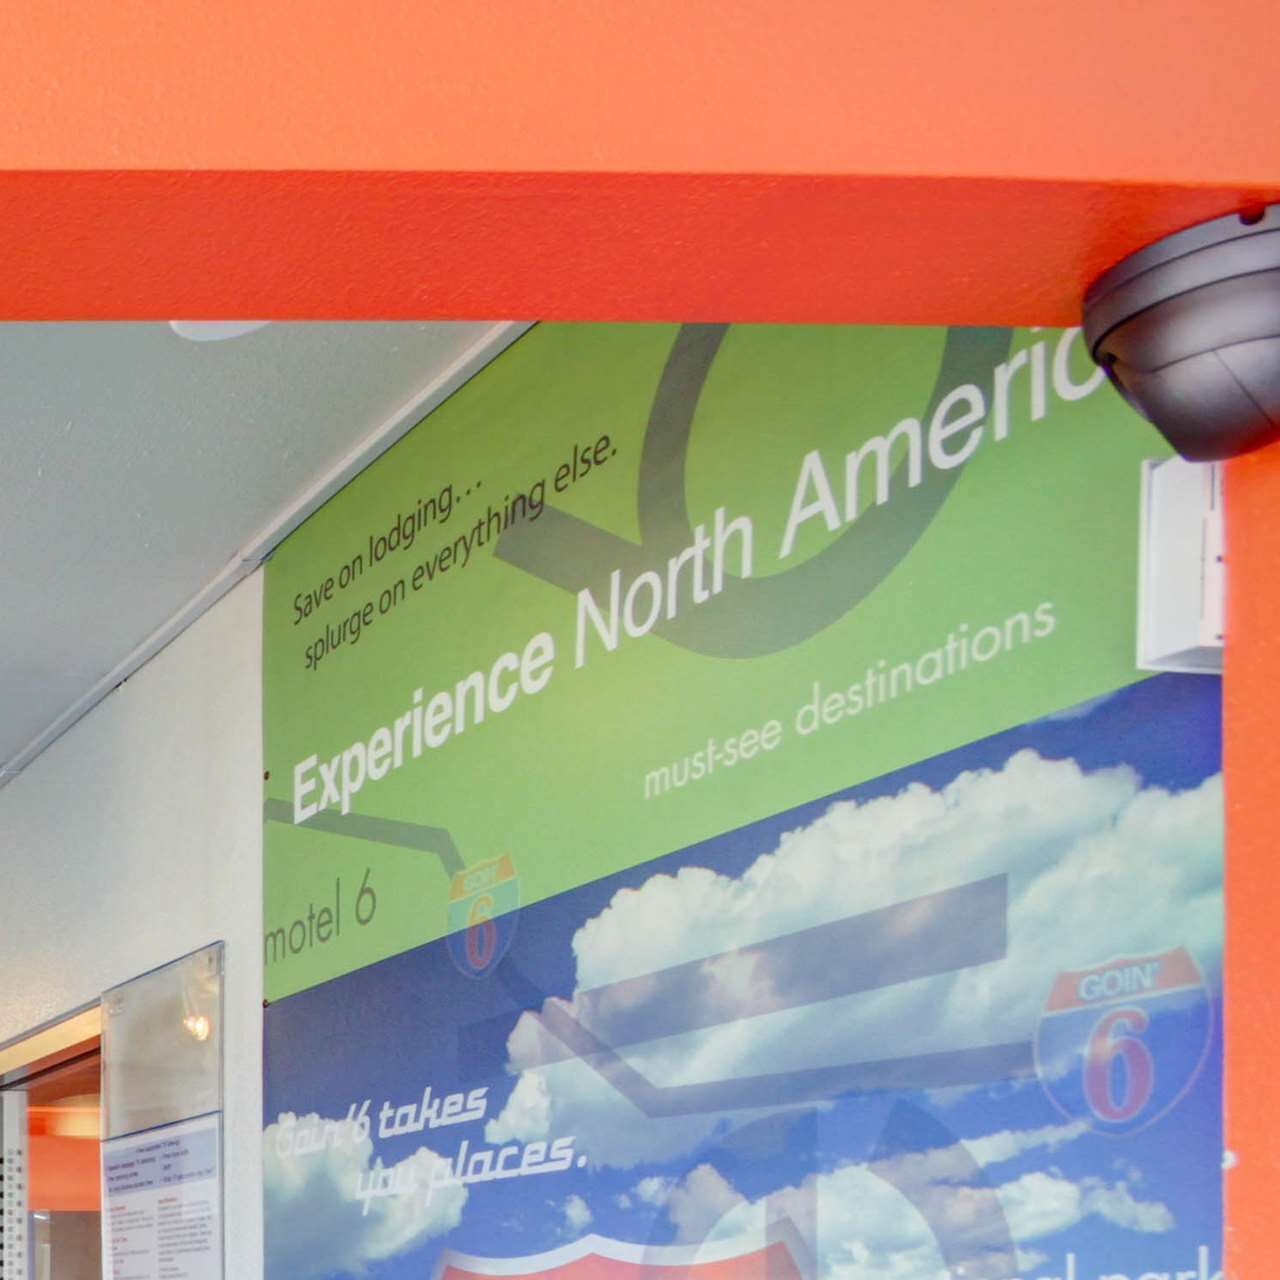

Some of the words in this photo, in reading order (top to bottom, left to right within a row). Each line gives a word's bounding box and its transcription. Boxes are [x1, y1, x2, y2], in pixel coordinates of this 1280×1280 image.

[294, 632, 555, 825] Experience
[575, 507, 753, 669] North
[780, 327, 1106, 559] Americ
[294, 577, 334, 626] Save
[339, 554, 363, 589] on
[305, 601, 373, 671] splurge
[379, 582, 405, 614] on
[413, 478, 545, 592] everything
[554, 434, 617, 493] else.
[644, 719, 781, 799] must-see
[796, 601, 1055, 736] destinations
[263, 878, 341, 966] motel
[355, 868, 376, 926] 6
[465, 893, 496, 971] 6
[1078, 960, 1161, 1001] GOIN'
[1082, 1005, 1154, 1123] 6
[379, 1086, 489, 1139] takes
[426, 1136, 588, 1208] places.
